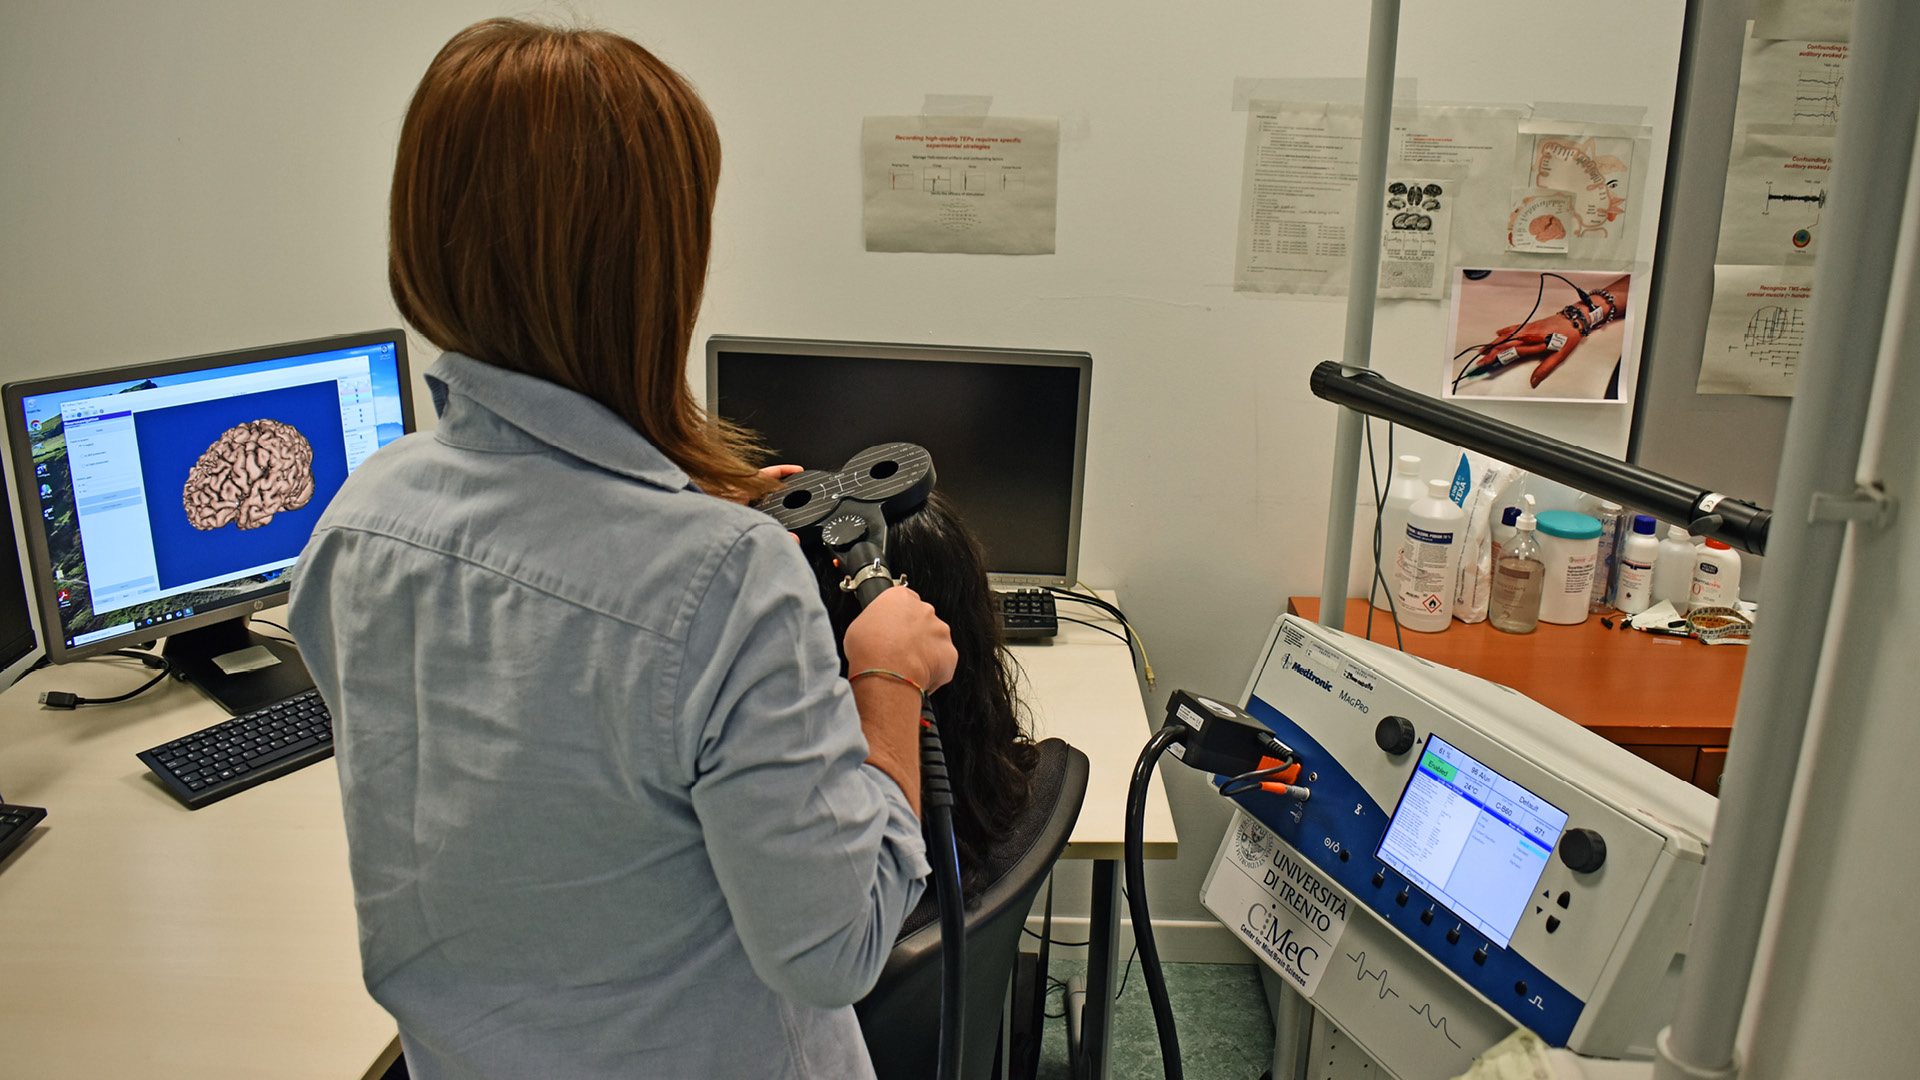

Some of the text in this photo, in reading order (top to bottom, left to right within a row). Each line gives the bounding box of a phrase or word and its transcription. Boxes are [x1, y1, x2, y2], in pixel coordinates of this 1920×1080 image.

[1807, 44, 1842, 52] Confounding
[1792, 156, 1826, 164] Confounding
[1292, 662, 1333, 692] Medtronic
[1428, 760, 1448, 777] Enabled
[1464, 782, 1478, 794] 24°C
[1518, 796, 1539, 812] Default
[1534, 826, 1545, 836] 571
[1273, 850, 1348, 921] UNIVERSITÀ
[1263, 869, 1331, 932] DI TRENTO
[1240, 924, 1306, 987] Center for Mind/Brain Sciences
